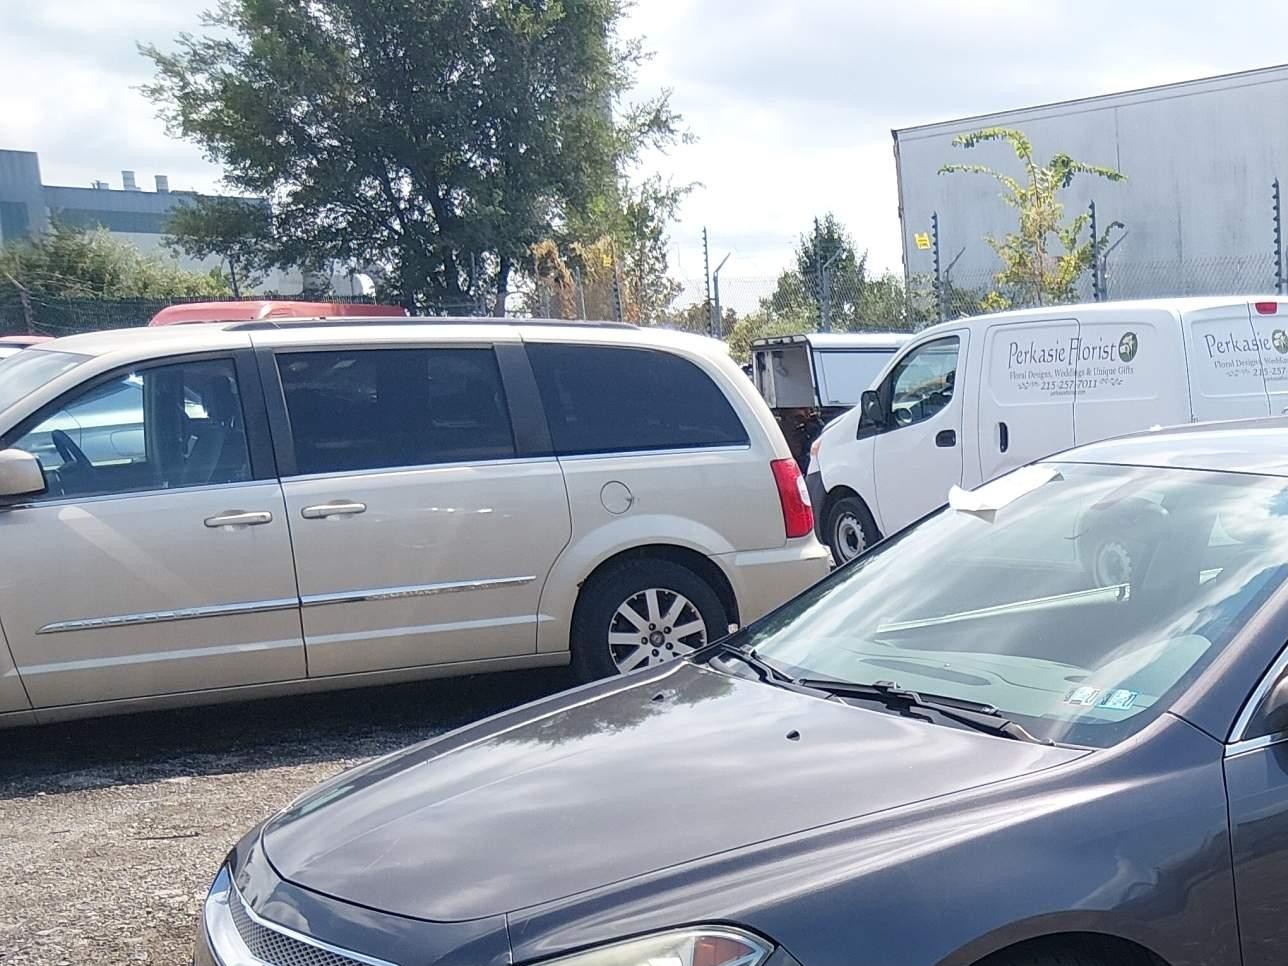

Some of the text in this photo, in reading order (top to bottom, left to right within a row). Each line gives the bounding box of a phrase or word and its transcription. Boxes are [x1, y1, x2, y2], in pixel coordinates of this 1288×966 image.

[1008, 336, 1117, 369] Perkasie Florist
[1204, 331, 1272, 359] Perkasie
[1093, 367, 1116, 378] Unique
[1117, 365, 1134, 376] Gifts
